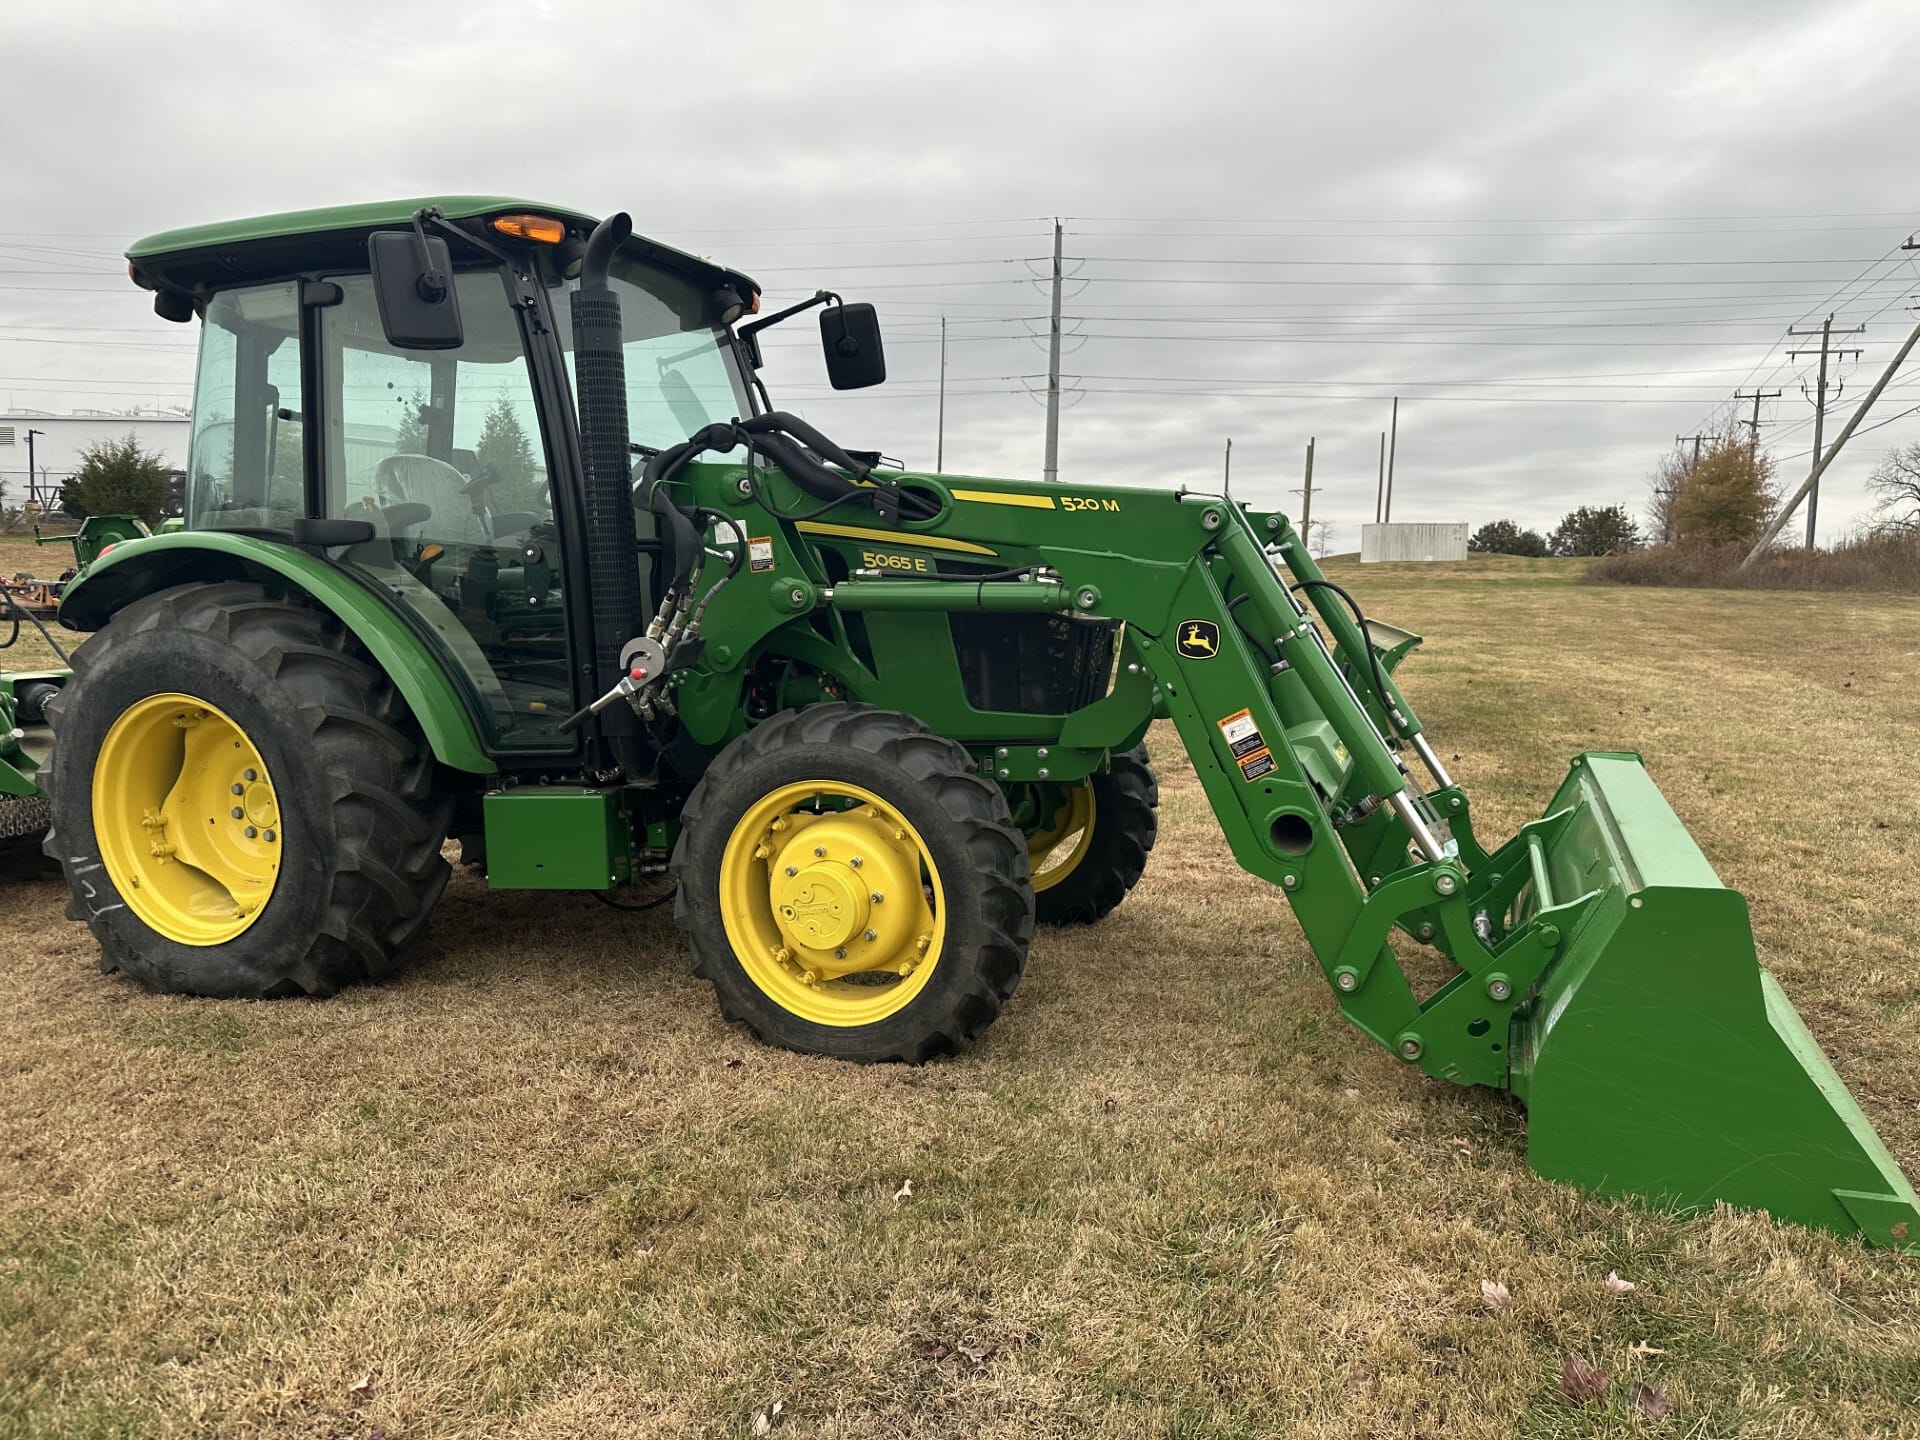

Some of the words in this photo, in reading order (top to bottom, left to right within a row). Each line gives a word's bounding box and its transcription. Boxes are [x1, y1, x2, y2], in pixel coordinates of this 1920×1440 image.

[1060, 496, 1099, 512] 520
[1101, 498, 1121, 512] M
[862, 551, 912, 570] 5065
[914, 558, 928, 572] E
